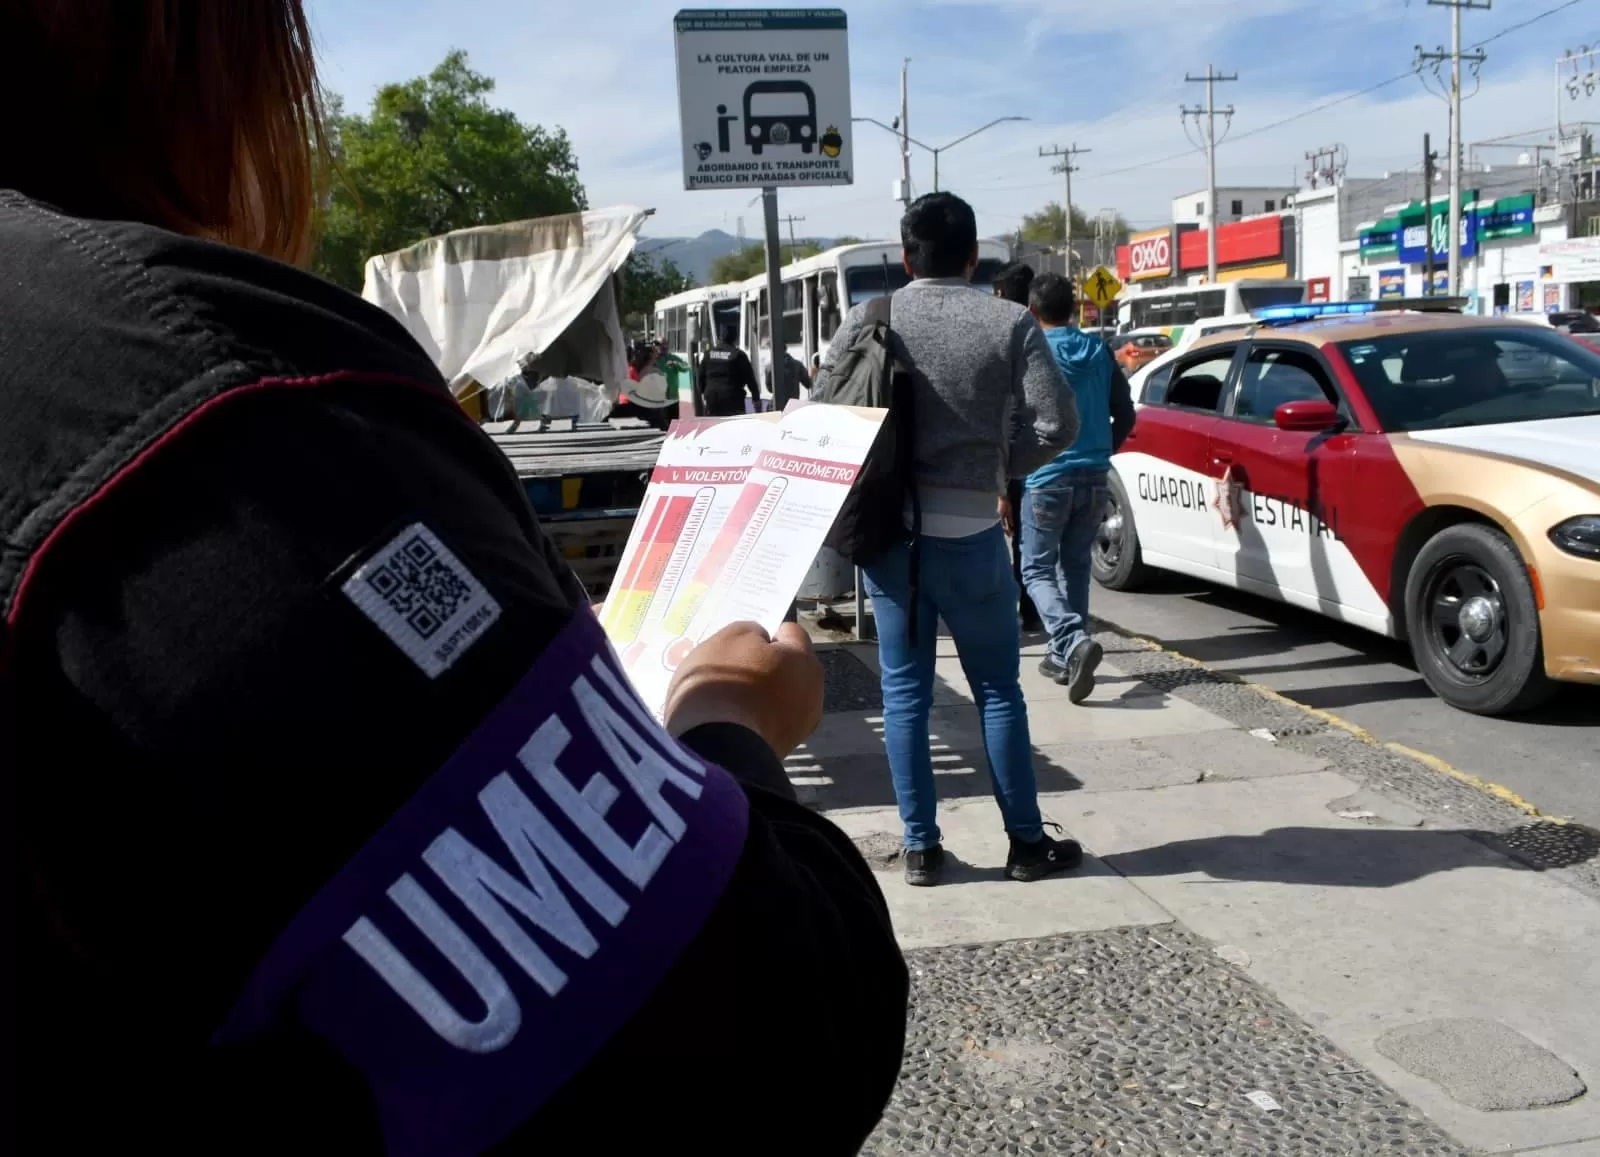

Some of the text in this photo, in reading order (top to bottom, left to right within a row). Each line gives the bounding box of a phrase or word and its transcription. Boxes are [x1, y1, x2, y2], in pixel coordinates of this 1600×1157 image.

[697, 52, 830, 63] LA CULTURA VIAL DE UN
[718, 64, 812, 74] PEATON EMPIEZA
[697, 160, 841, 173] ABORDANDO EL TRANSPORTE
[736, 174, 749, 183] EN
[752, 172, 796, 182] PARADAS
[799, 170, 849, 181] OFICIALES
[1132, 238, 1169, 271] OXXO
[762, 455, 855, 482] VIOLENTÓMETRO
[1138, 472, 1208, 512] GUARDIA
[1252, 491, 1345, 542] ESTATAL
